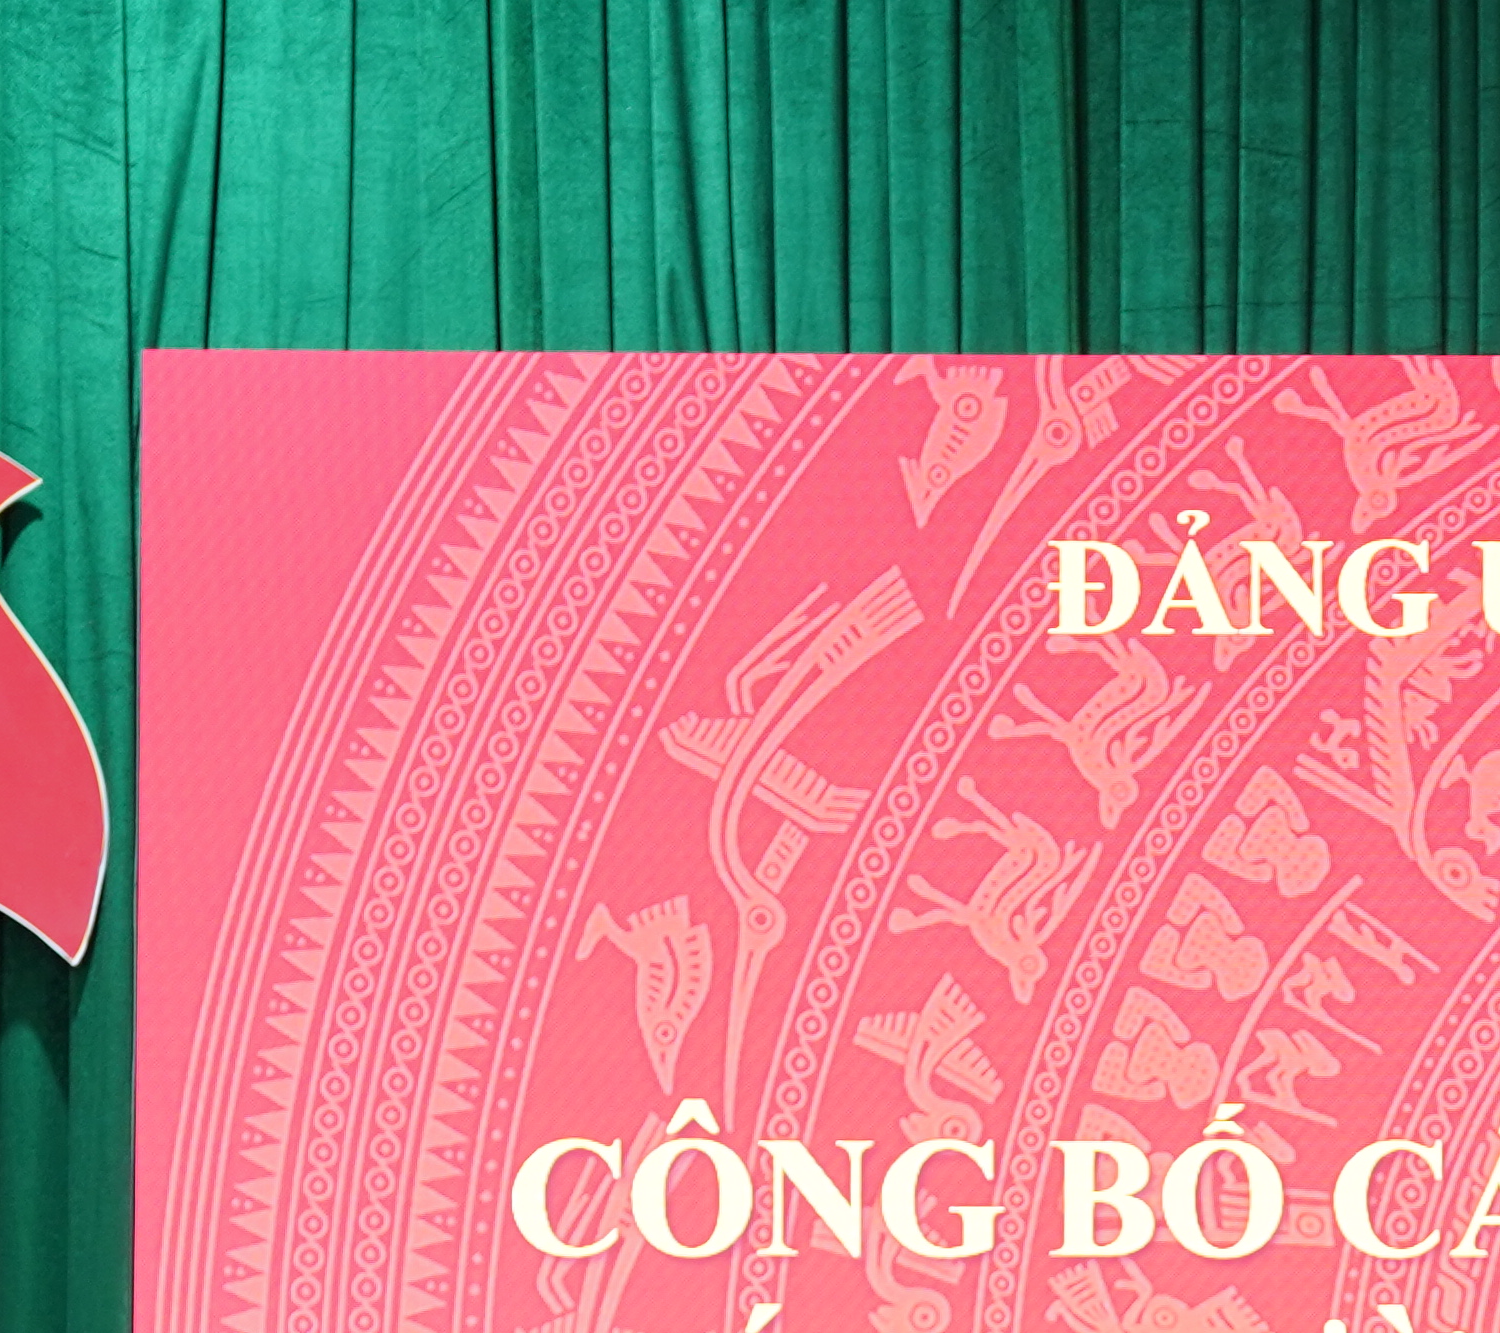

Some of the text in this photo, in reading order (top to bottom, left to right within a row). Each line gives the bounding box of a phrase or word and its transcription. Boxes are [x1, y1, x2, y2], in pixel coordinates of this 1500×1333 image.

[1046, 508, 1439, 638] ĐẢNG
[510, 1097, 1006, 1259] CÔNG
[1048, 1102, 1284, 1259] BỐ
